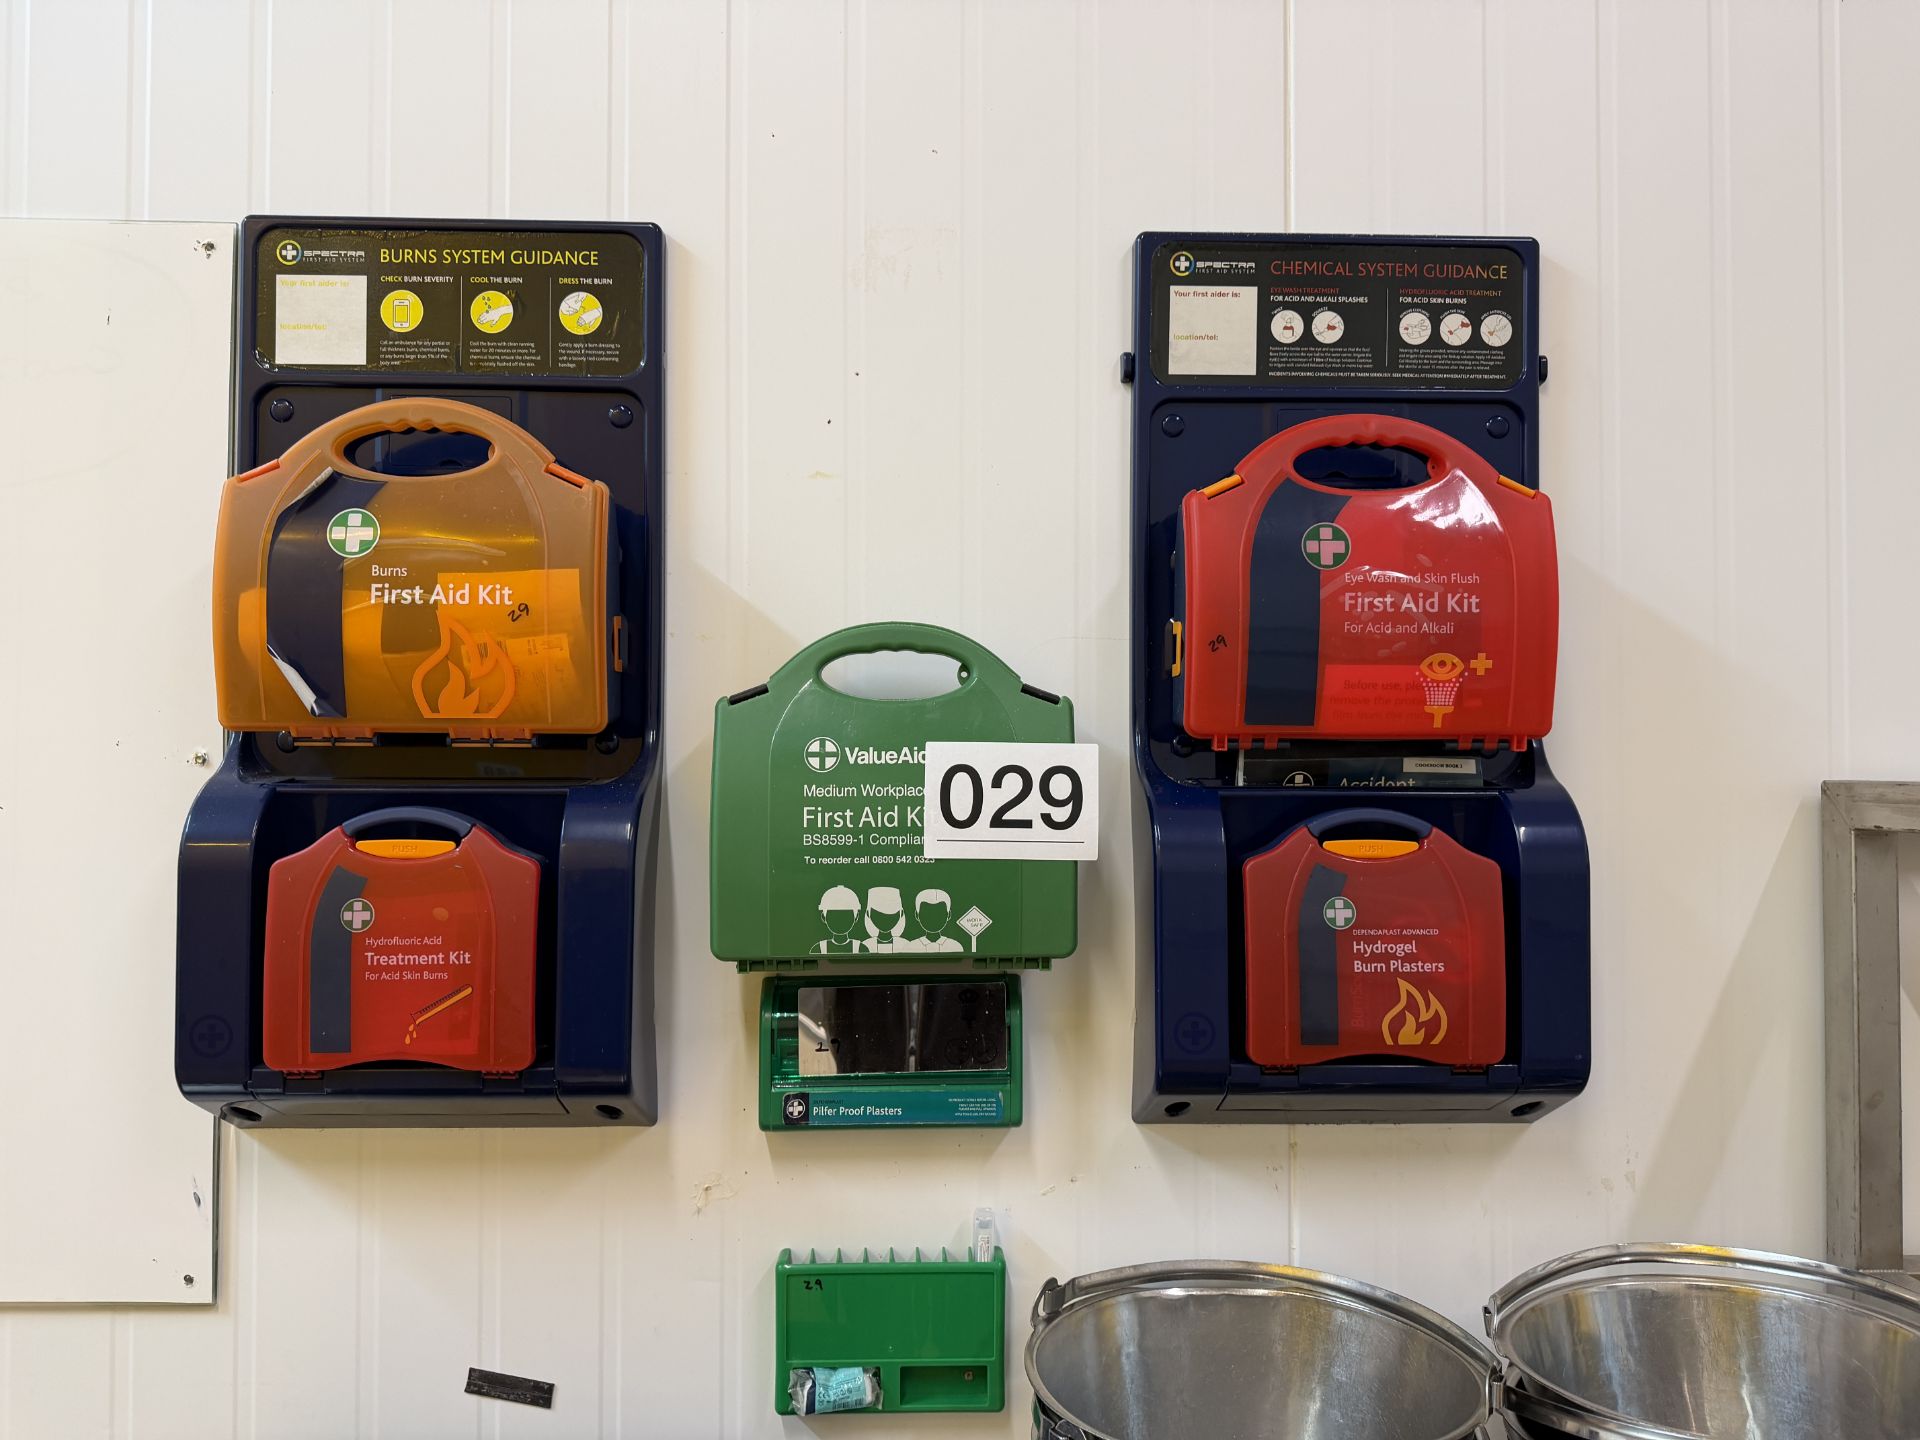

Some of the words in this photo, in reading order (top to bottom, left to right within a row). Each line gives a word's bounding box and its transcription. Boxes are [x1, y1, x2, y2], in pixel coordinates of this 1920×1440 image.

[380, 248, 437, 264] BURNS
[442, 249, 505, 265] SYSTEM
[510, 250, 599, 266] GUIDANCE
[1270, 260, 1353, 276] CHEMICAL
[1358, 262, 1418, 277] SYSTEM
[1423, 264, 1508, 279] GUIDANCE
[380, 275, 403, 283] CHECK
[403, 275, 423, 283] BURN
[490, 276, 502, 284] THE
[503, 276, 523, 284] BURN
[558, 277, 579, 285] DRESS
[1173, 290, 1190, 298] Your
[1193, 290, 1209, 298] first
[1210, 290, 1227, 298] aider
[1231, 290, 1241, 298] is:
[1338, 296, 1369, 304] SPLASHES
[1413, 296, 1429, 304] ACID
[1445, 297, 1467, 305] BURNS
[1173, 333, 1219, 341] location/tel:
[371, 564, 408, 577] Burns
[1344, 572, 1364, 586] Eye
[1366, 572, 1397, 584] Wash
[1400, 572, 1420, 584] and
[1424, 573, 1448, 584] Skin
[1451, 573, 1480, 584] Flush
[370, 583, 424, 605] First
[429, 583, 470, 605] Aid
[478, 584, 513, 605] Kit
[1344, 592, 1395, 612] First
[1400, 592, 1439, 613] Aid
[1447, 592, 1480, 613] Kit
[507, 602, 530, 623] 29
[1344, 622, 1363, 633] For
[1366, 622, 1392, 633] Acid
[1395, 622, 1418, 633] and
[1420, 622, 1454, 634] Alkali
[1207, 634, 1228, 653] 29
[803, 784, 857, 797] Medium
[860, 784, 926, 799] Workplac
[939, 763, 1085, 831] 029
[803, 806, 854, 828] First
[859, 805, 899, 828] Aid
[803, 834, 864, 846] BS8599-1
[391, 845, 418, 853] PUSH
[1359, 845, 1384, 853] PUSH
[804, 856, 816, 864] To
[818, 856, 853, 864] reorder
[854, 856, 870, 864] call
[872, 855, 894, 864] 0800
[895, 855, 912, 864] 542
[366, 936, 422, 949] Hydrofluoric
[422, 936, 442, 945] Acid
[1353, 940, 1418, 957] Hydrogel
[364, 951, 445, 966] Treatment
[449, 950, 472, 965] Kit
[1354, 960, 1386, 973] Burn
[1390, 959, 1445, 973] Plasters
[365, 971, 379, 980] For
[380, 971, 400, 980] Acid
[402, 971, 421, 980] Skin
[423, 971, 449, 980] Burns
[813, 1106, 837, 1116] Pilfer
[839, 1105, 865, 1116] Proof
[866, 1105, 903, 1116] Plasters
[803, 1278, 824, 1291] 29
